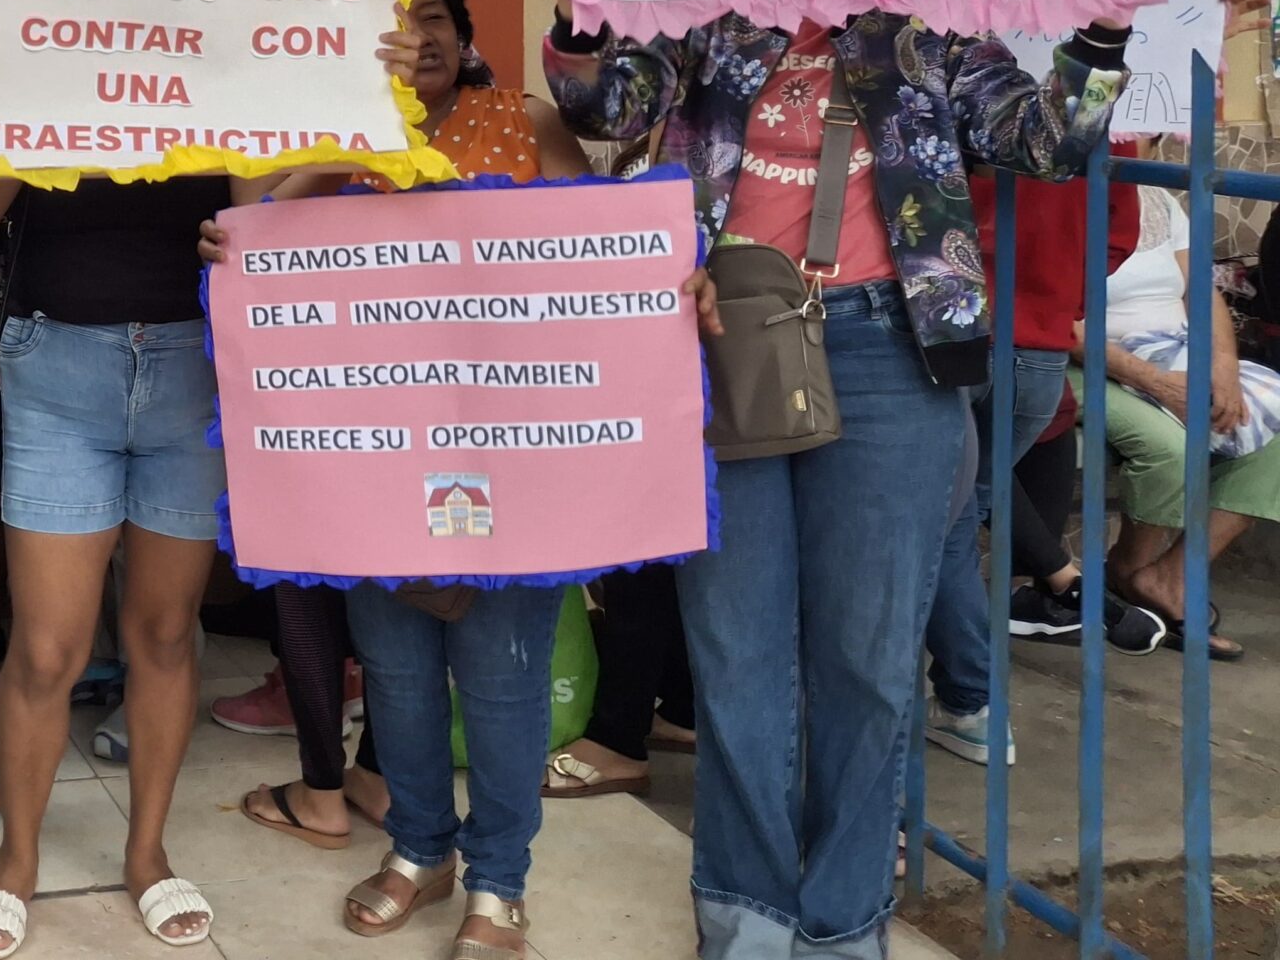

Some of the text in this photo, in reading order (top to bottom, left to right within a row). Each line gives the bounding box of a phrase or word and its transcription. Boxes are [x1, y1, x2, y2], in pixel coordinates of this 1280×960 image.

[21, 18, 204, 54] CONTAR
[252, 26, 346, 56] CON
[97, 73, 190, 105] UNA
[243, 233, 667, 273] ESTAMOS EN LA VANGUARDIA
[251, 305, 285, 326] DE
[292, 303, 323, 324] LA
[354, 296, 530, 324] INNOVACION
[255, 362, 594, 390] LOCAL ESCOLAR TAMBIEN
[259, 420, 634, 450] MERECE SU OPORTUNIDAD
